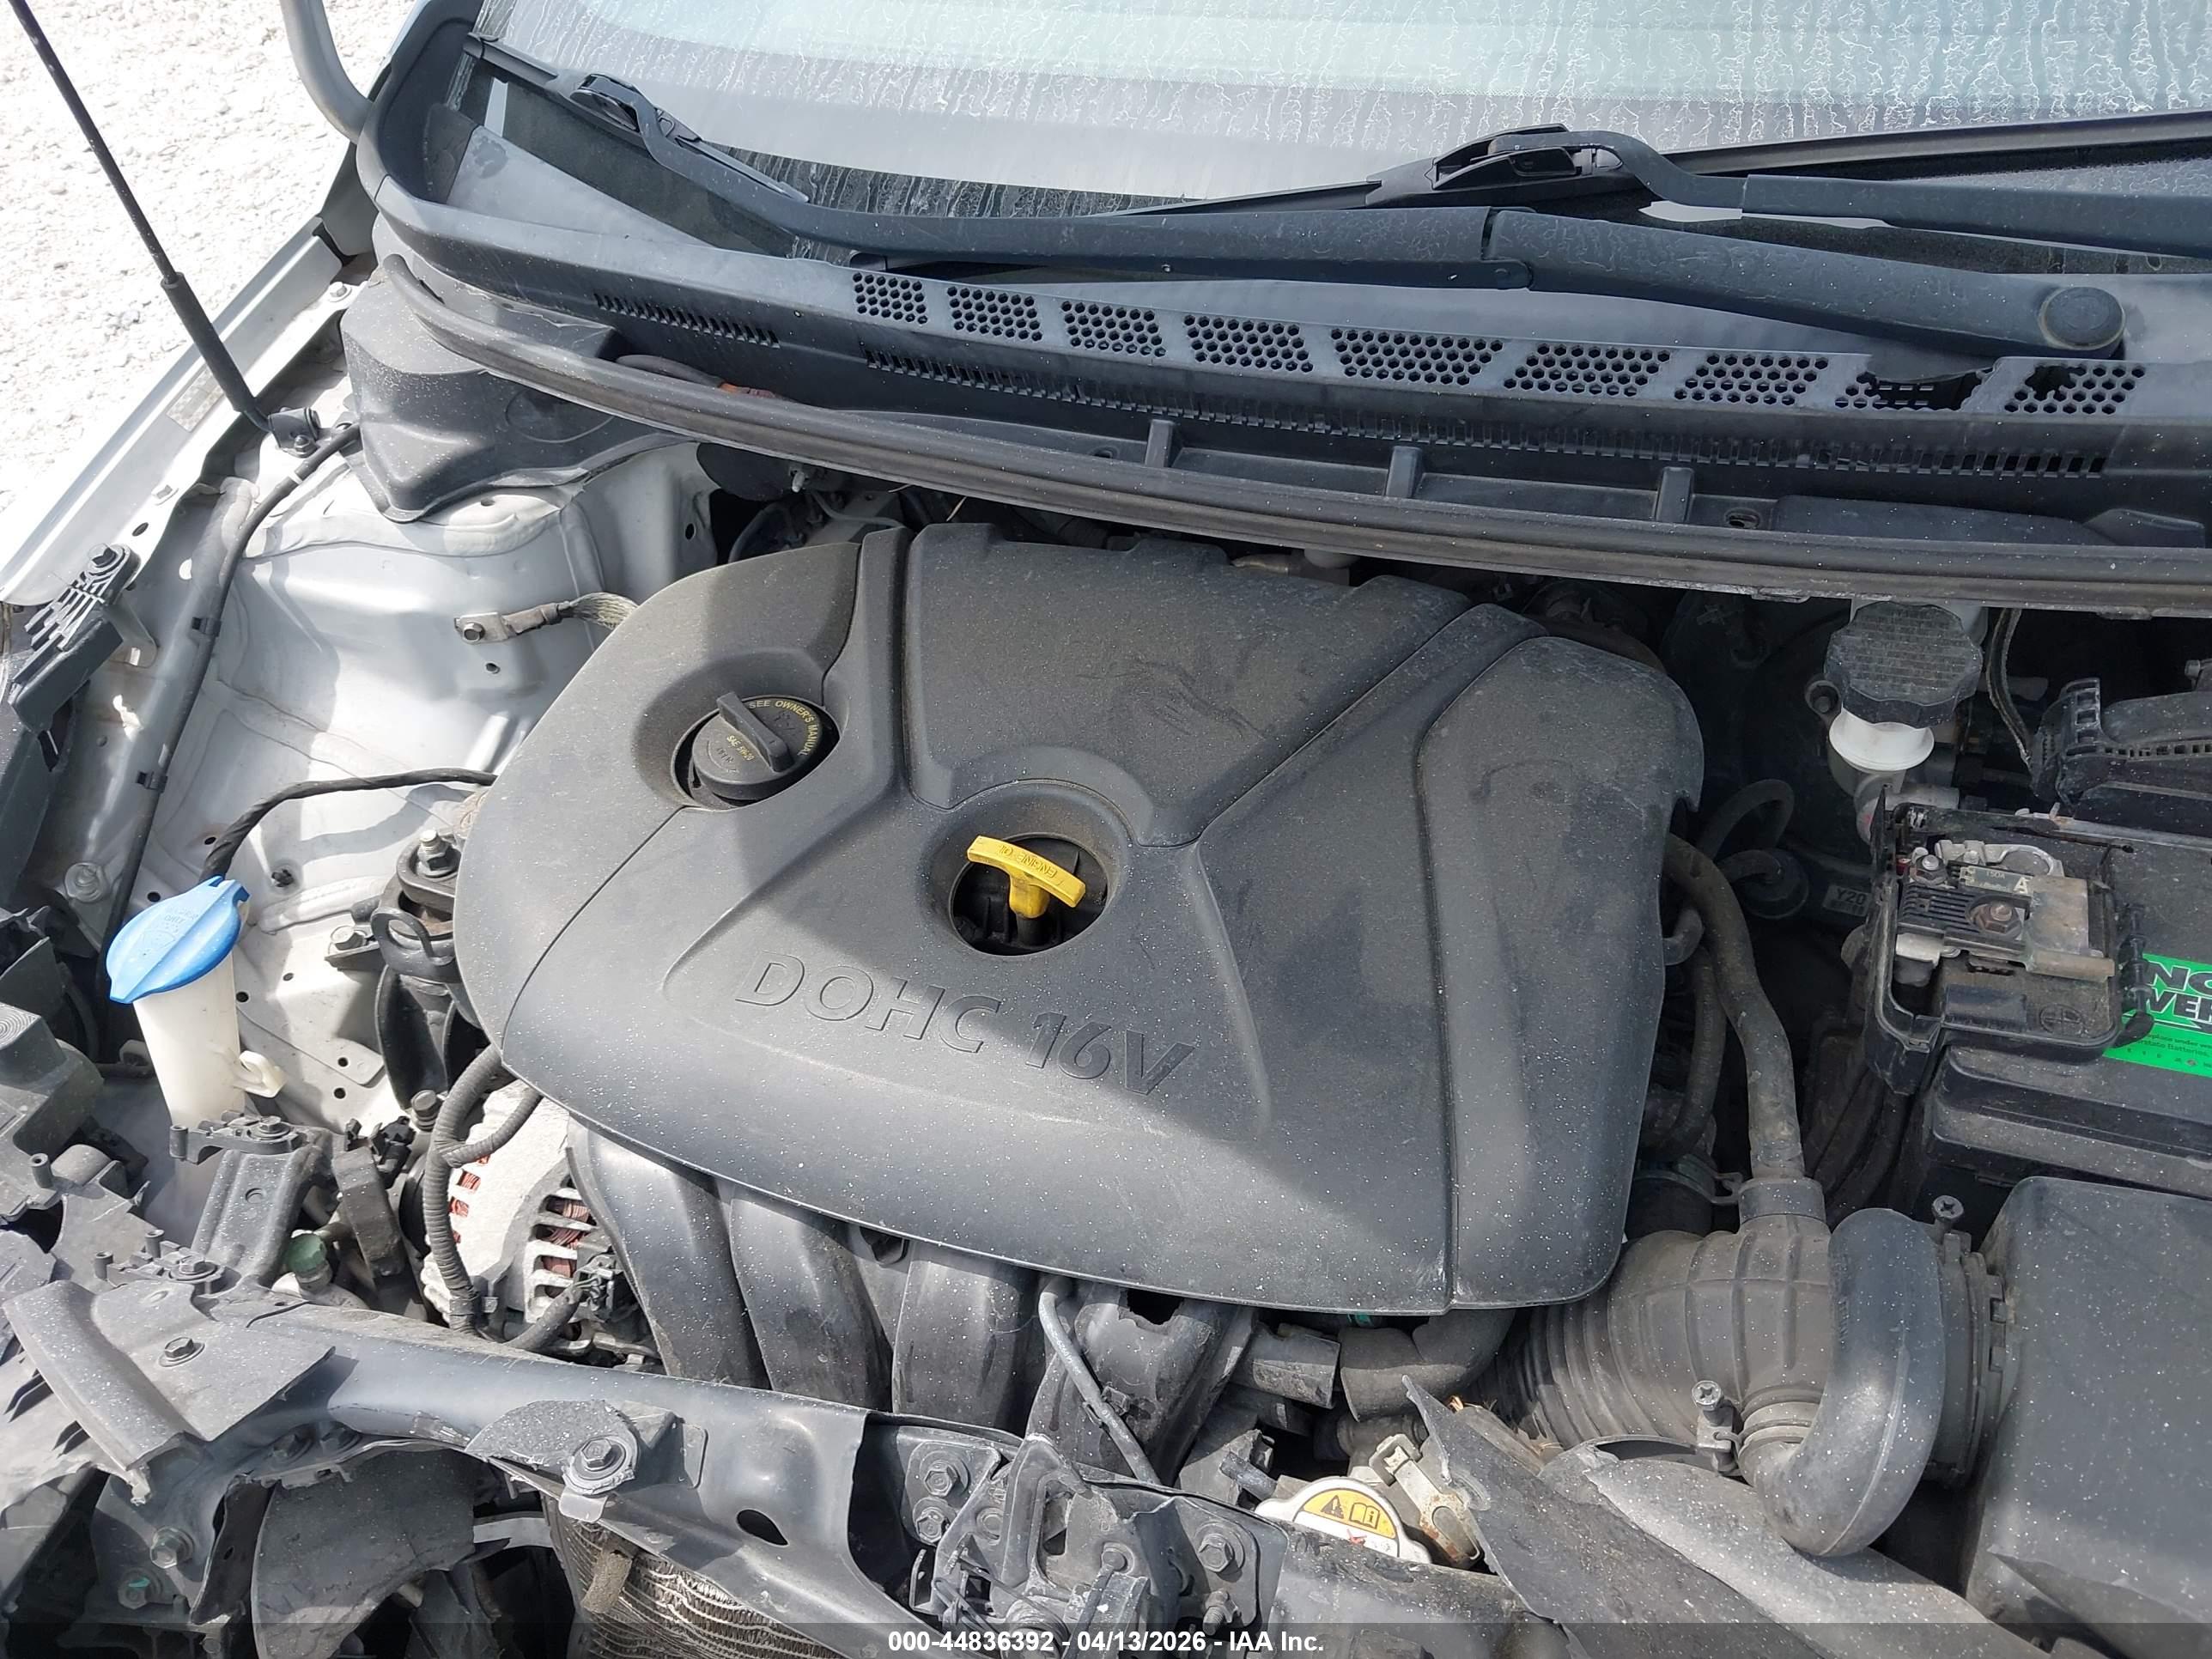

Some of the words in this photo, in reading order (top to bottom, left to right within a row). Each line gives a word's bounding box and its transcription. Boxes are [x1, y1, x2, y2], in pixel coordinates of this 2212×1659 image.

[749, 700, 771, 708] SEE
[775, 700, 815, 723] OWNER'S
[797, 725, 818, 756] MANUAL
[735, 950, 1003, 1054] DOHC
[1024, 1011, 1197, 1096] 16V
